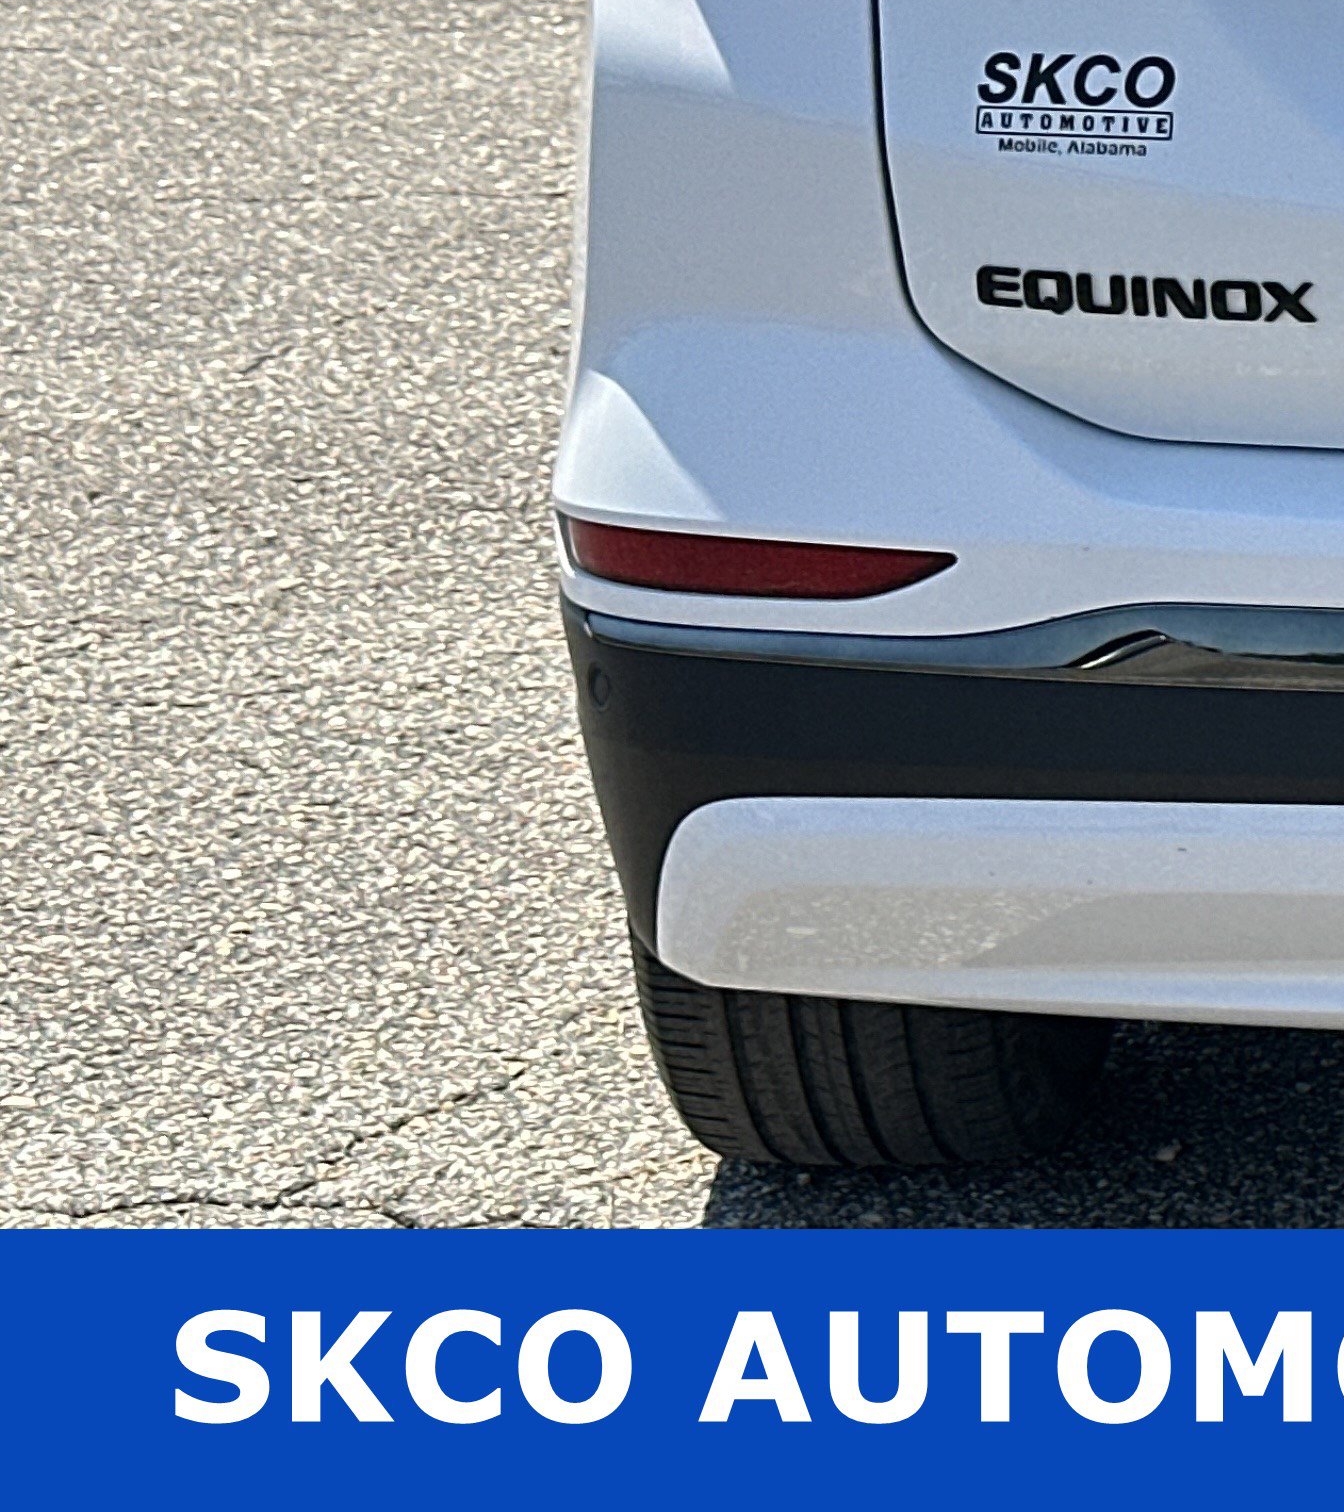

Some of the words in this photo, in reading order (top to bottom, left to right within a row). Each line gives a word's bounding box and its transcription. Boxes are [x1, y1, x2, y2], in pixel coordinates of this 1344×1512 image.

[976, 51, 1176, 109] SKCO
[980, 111, 1169, 135] AUTOMOTIVE
[997, 137, 1063, 156] Mobile,
[1066, 139, 1148, 157] Alabama
[976, 264, 1317, 323] EQUINOX
